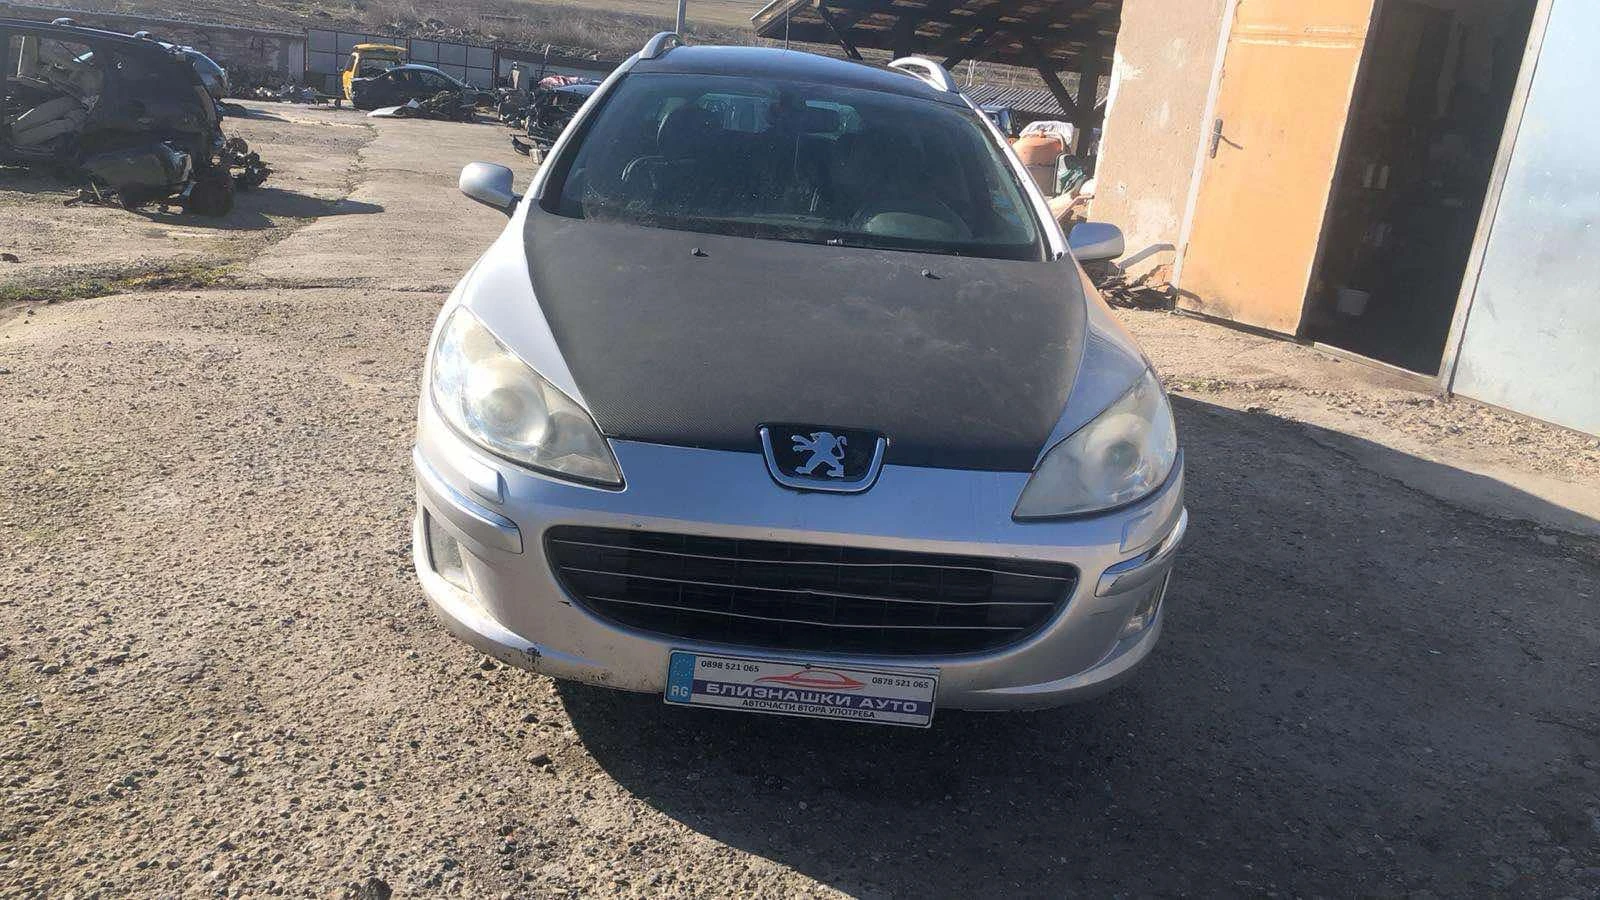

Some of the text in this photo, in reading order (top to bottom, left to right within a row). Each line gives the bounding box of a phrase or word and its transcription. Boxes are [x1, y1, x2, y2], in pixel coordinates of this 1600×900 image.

[701, 660, 760, 673] 0898 521 065
[871, 676, 929, 689] 0878 521 065
[706, 683, 918, 713] БЛИЗНАШКИ АУТО
[742, 699, 875, 718] АВТОЧАСТИ ВТОРА УПОТРЕБА
